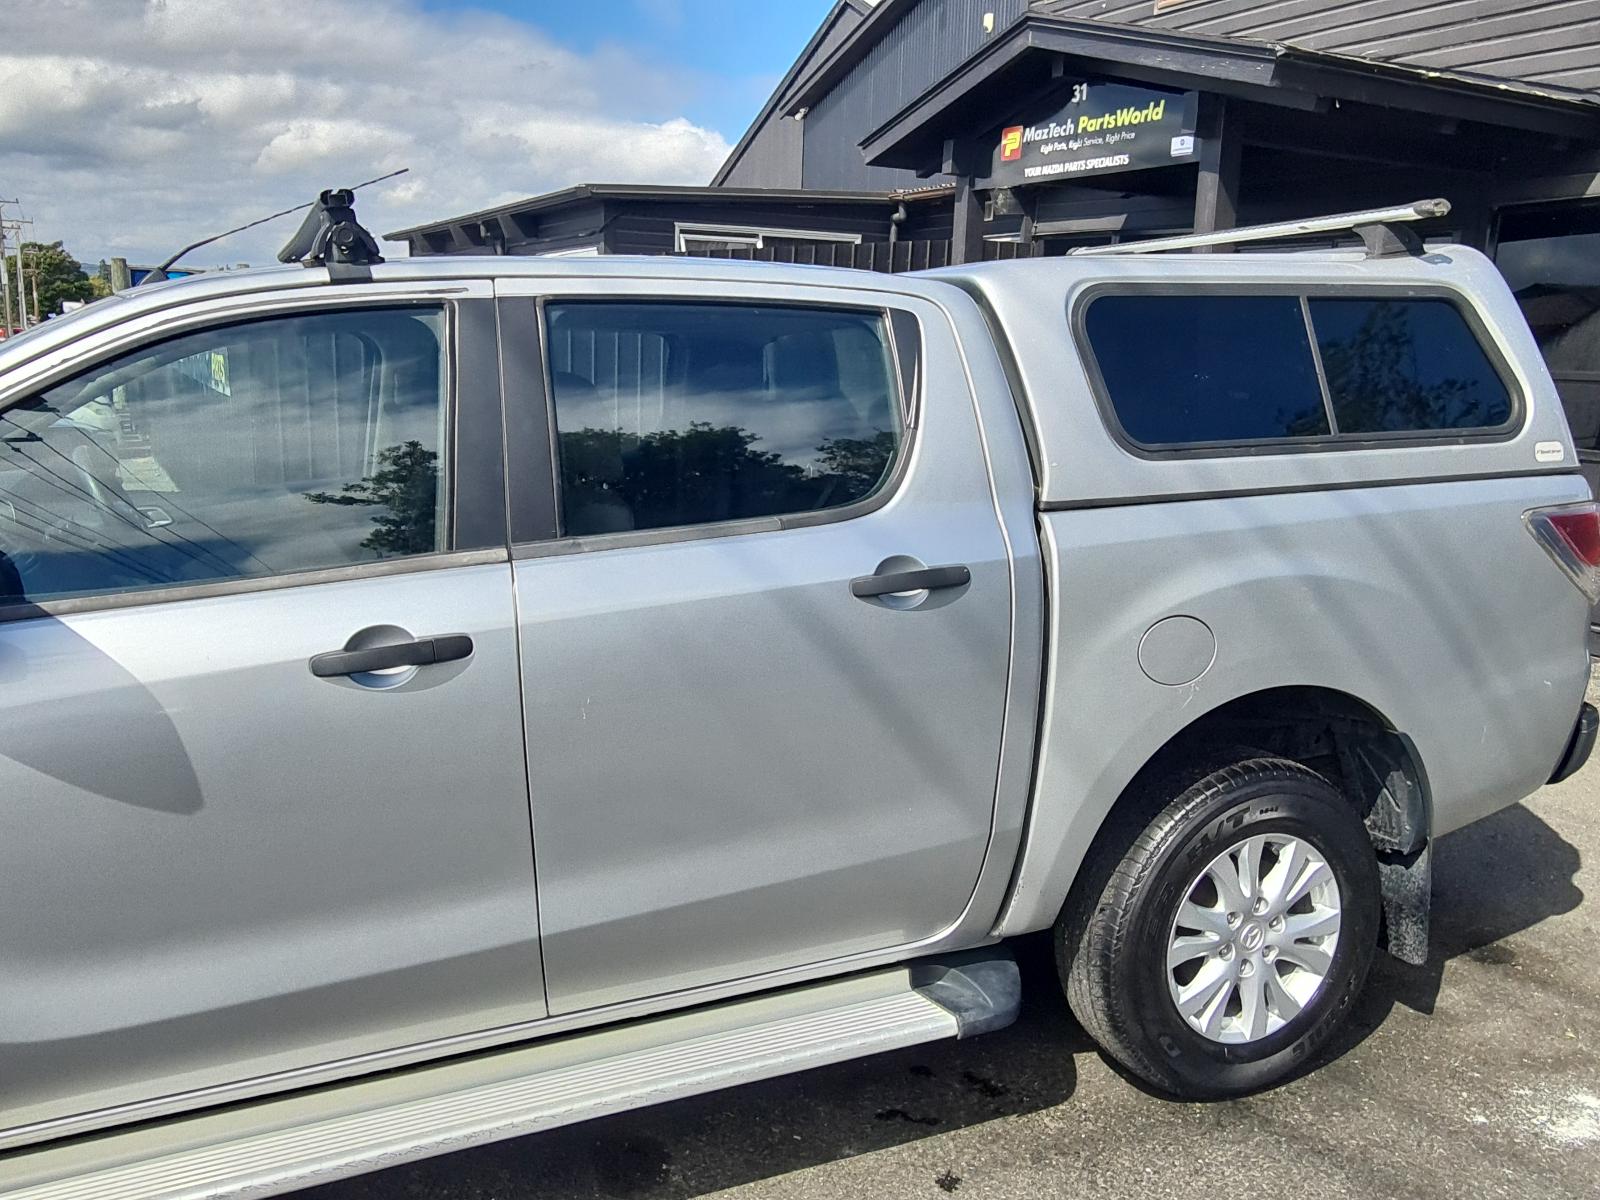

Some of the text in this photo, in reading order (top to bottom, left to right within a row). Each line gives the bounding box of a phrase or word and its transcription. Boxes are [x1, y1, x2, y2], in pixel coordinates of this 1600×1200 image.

[1071, 83, 1088, 103] 31
[1022, 100, 1165, 143] MazTech PartsWorld
[1105, 132, 1120, 145] Right
[1120, 131, 1136, 140] Price
[1024, 154, 1130, 177] YOUR MAZDA PARTS SPECIALISTS
